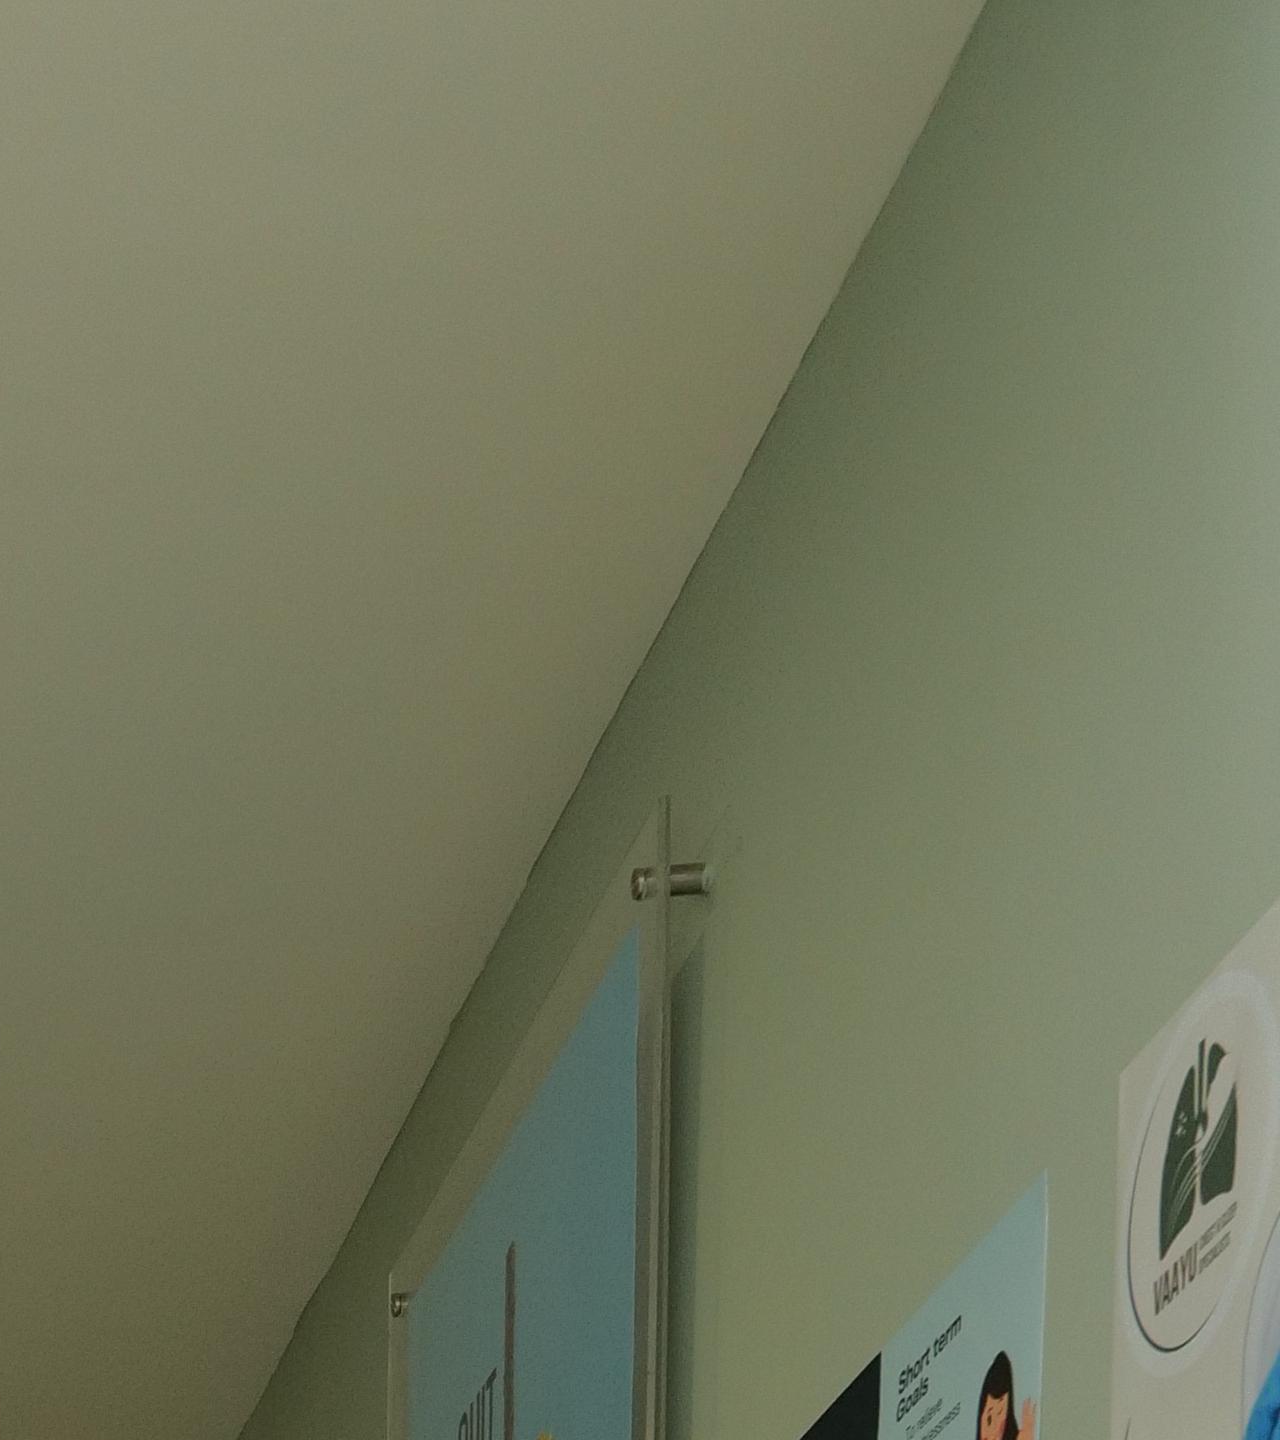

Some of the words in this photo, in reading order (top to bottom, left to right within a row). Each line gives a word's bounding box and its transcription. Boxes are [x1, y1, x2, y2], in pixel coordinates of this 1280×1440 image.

[1153, 1243, 1197, 1315] VAAYU
[898, 1347, 930, 1394] Short
[933, 1315, 961, 1357] term
[895, 1376, 928, 1422] Goals
